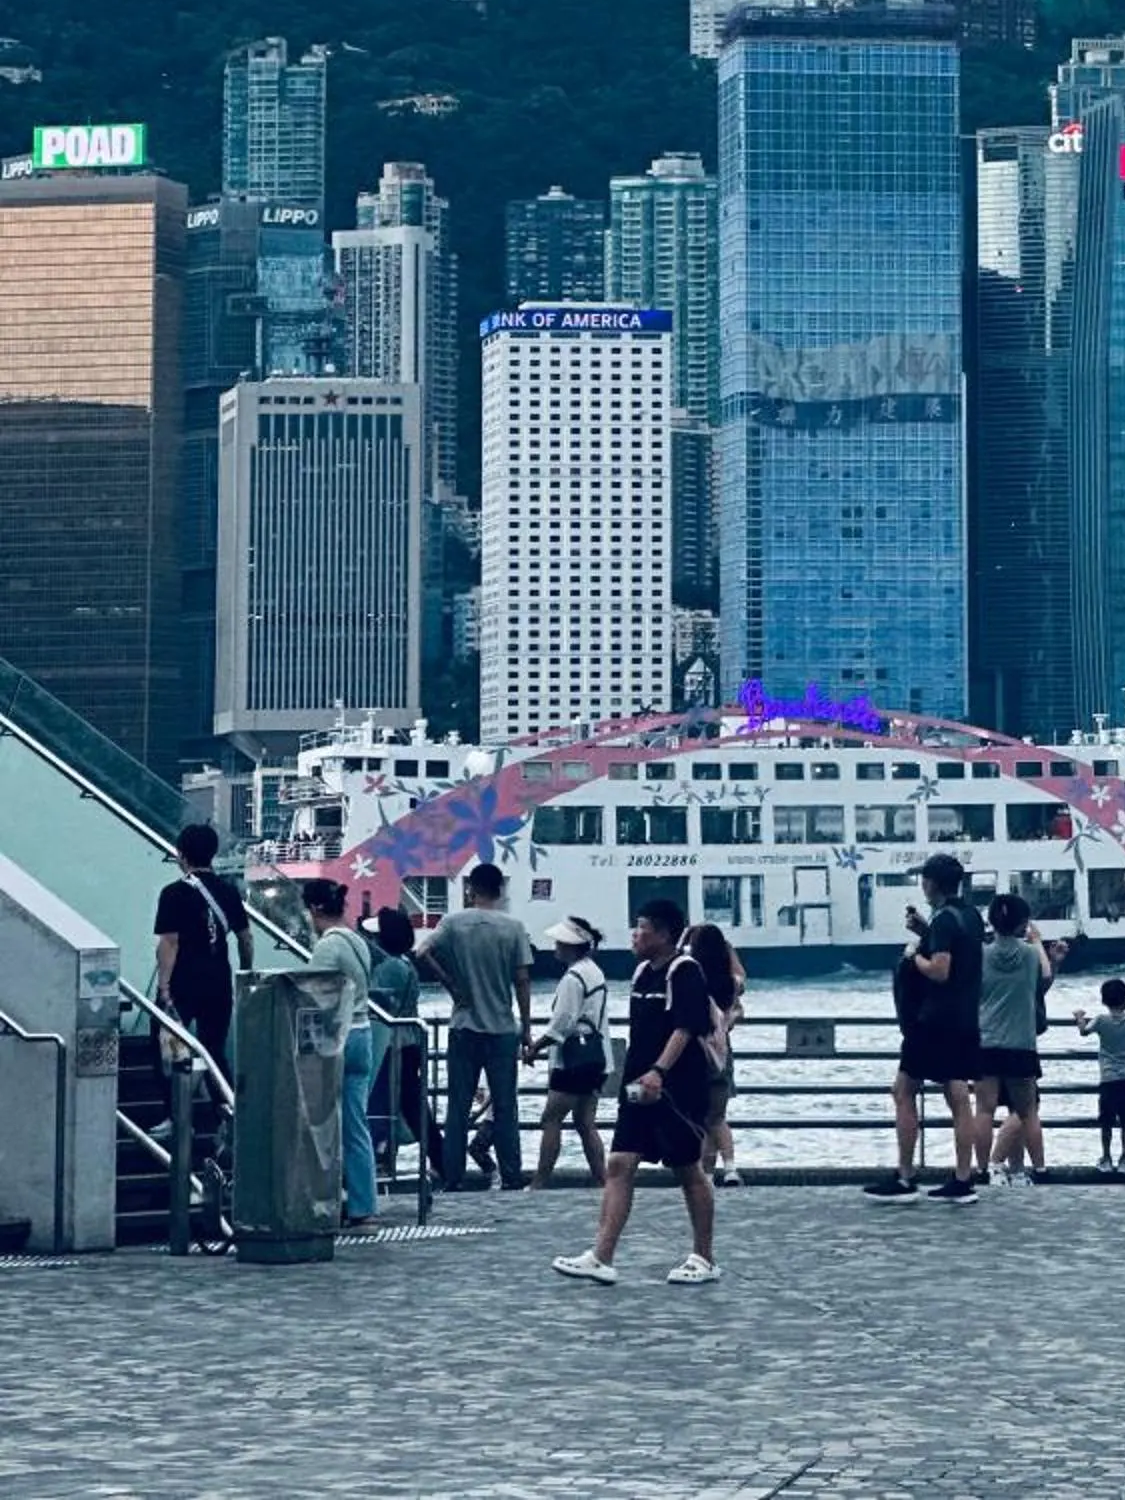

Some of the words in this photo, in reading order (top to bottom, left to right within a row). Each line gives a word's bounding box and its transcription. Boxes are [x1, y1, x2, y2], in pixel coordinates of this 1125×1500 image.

[41, 126, 135, 166] POAD
[1048, 127, 1083, 153] cit
[187, 208, 219, 229] LIPPO
[263, 207, 318, 225] LIPPO
[531, 312, 556, 327] OF
[561, 313, 642, 328] AMERICA
[627, 853, 698, 867] 28022886
